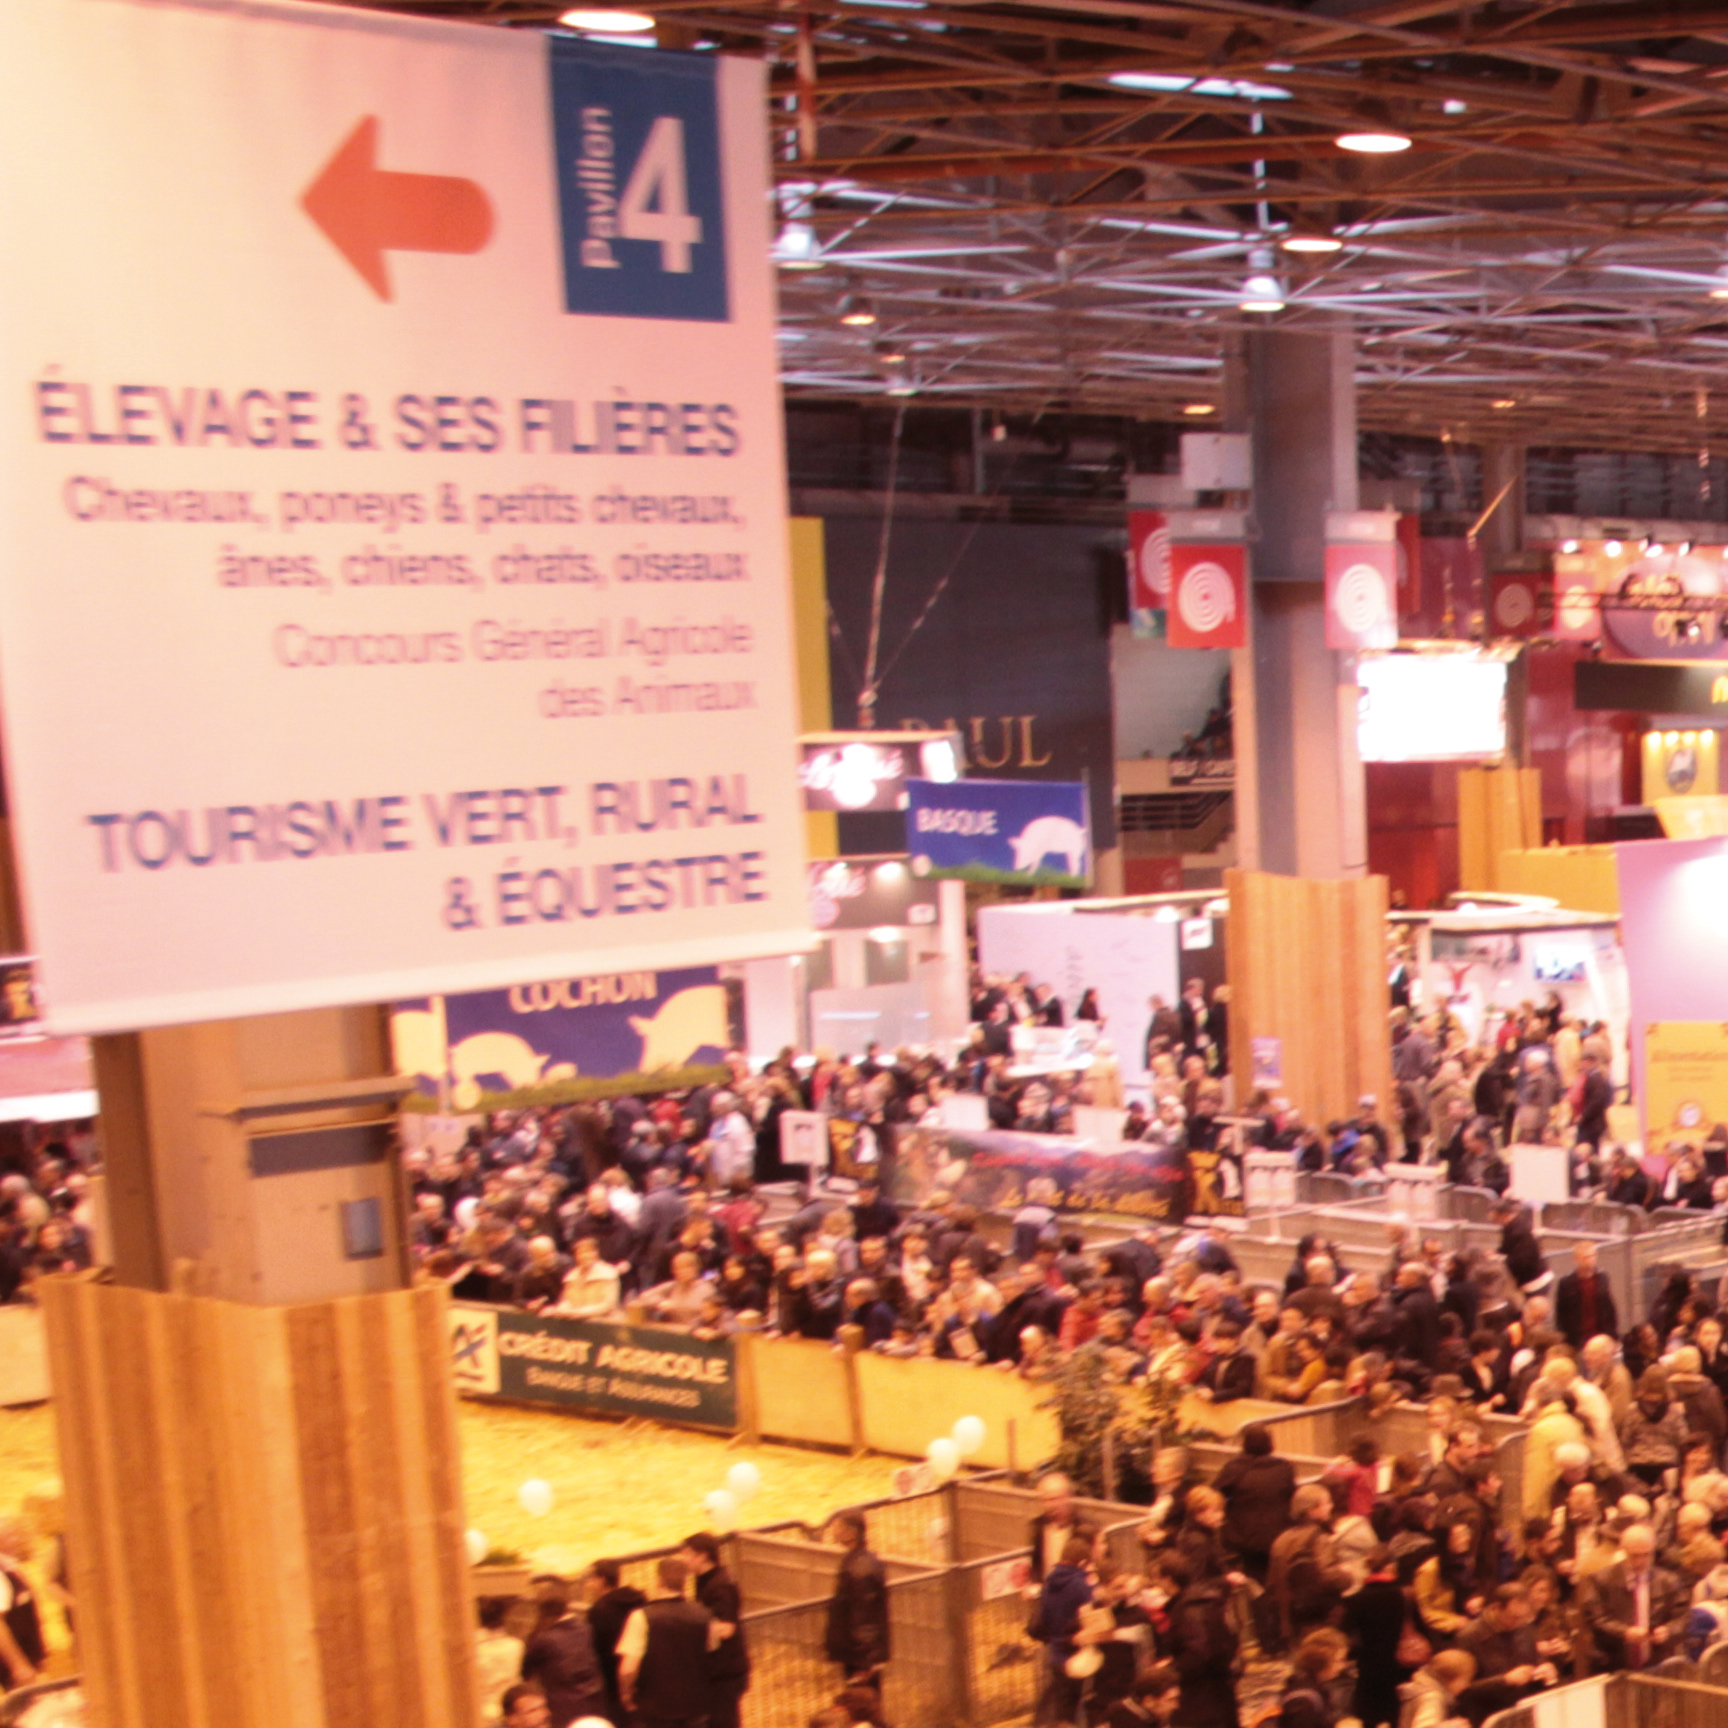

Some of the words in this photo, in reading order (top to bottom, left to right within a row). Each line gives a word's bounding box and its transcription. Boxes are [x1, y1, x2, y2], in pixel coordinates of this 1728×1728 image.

[574, 106, 623, 269] Pavillon
[616, 114, 704, 273] 4
[33, 362, 325, 450] ÉLEVAGE
[340, 393, 384, 451] &
[395, 393, 502, 454] SES
[521, 384, 744, 457] FILIÈRES
[62, 474, 272, 531] Chevaux,
[278, 489, 428, 535] poneys
[435, 481, 468, 525] &
[474, 482, 581, 534] petits
[593, 484, 747, 531] chevaux,
[215, 542, 334, 595] ânes,
[340, 542, 485, 592] chiens,
[492, 543, 609, 591] chats,
[612, 542, 752, 582] oiseaux
[272, 622, 465, 669] Concours
[471, 616, 611, 662] Général
[620, 614, 754, 668] Agricole
[539, 678, 604, 719] des
[613, 674, 758, 717] Animaux
[83, 796, 416, 874] TOURISME
[421, 784, 580, 849] VERT,
[587, 773, 766, 836] RURAL
[916, 806, 999, 837] BASQUE
[440, 875, 484, 931] &
[494, 850, 770, 929] ÉQUESTRE
[499, 1330, 593, 1366] CRÉDIT
[595, 1343, 729, 1385] AGRICOLE
